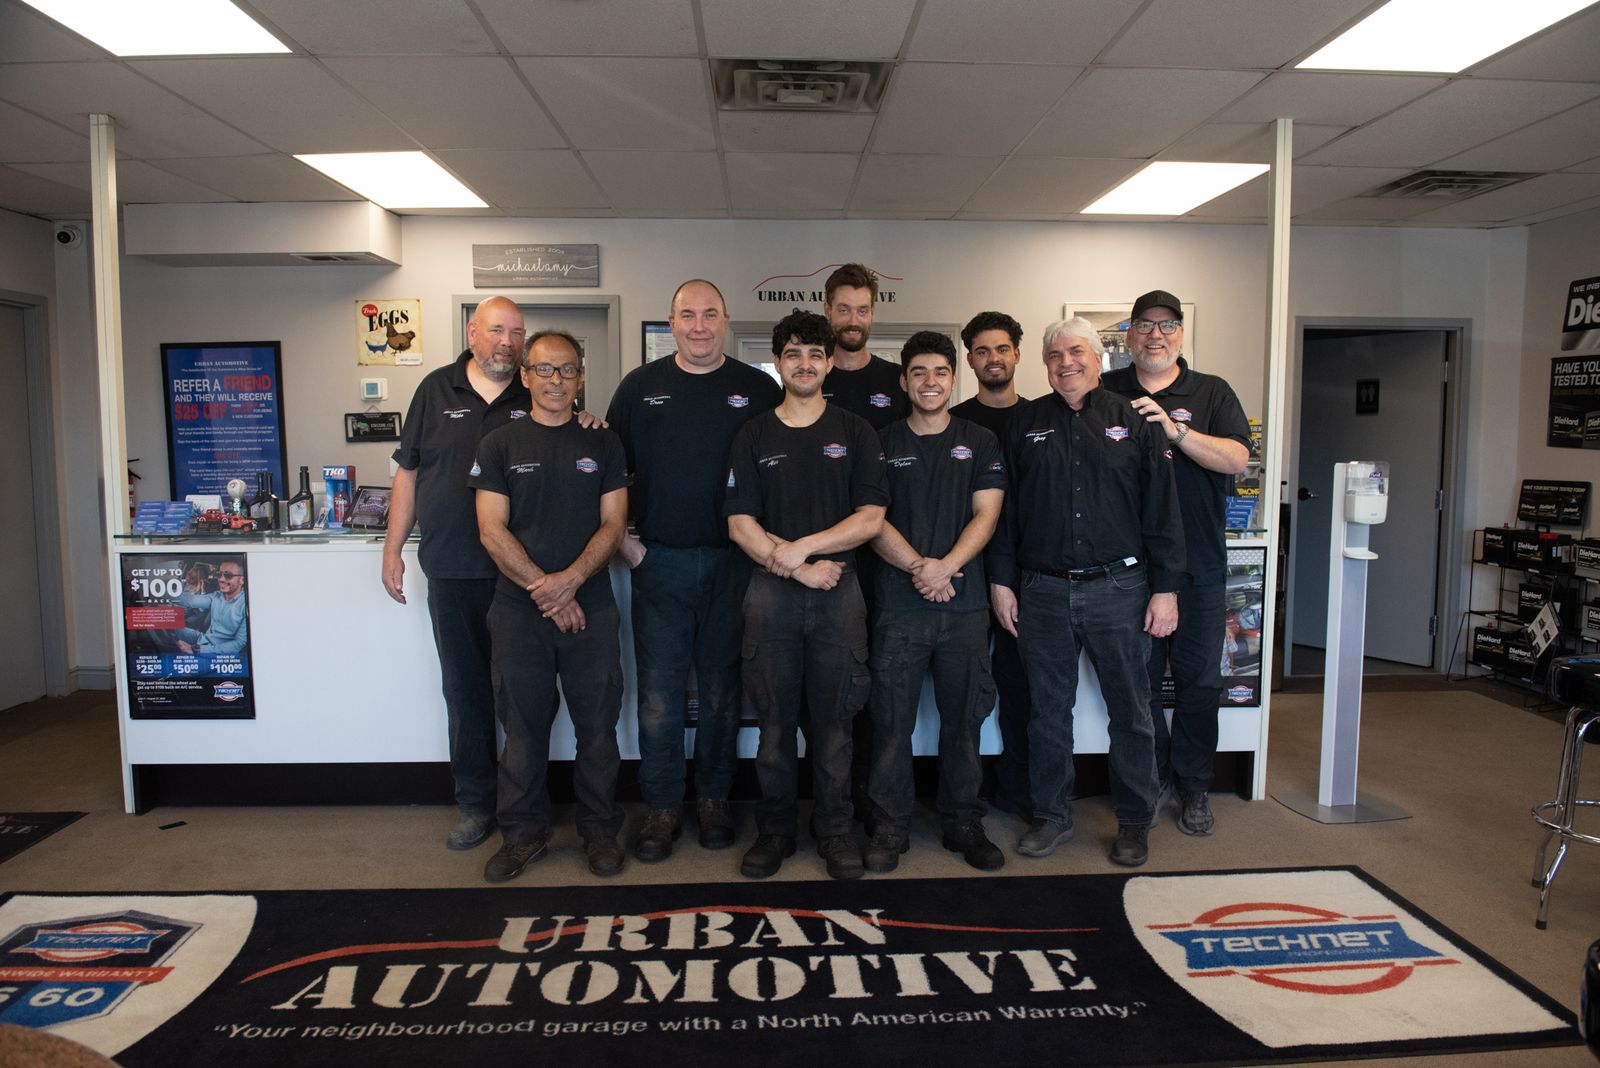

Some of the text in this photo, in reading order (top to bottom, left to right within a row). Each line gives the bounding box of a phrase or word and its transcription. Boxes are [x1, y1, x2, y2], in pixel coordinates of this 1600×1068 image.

[1573, 285, 1585, 293] WE
[758, 290, 806, 302] URBAN
[368, 310, 409, 332] EGGS
[1554, 362, 1580, 374] HAVE
[174, 375, 272, 392] REFER A FRIEND
[1553, 374, 1588, 386] TESTED
[174, 394, 192, 402] AND
[194, 394, 216, 402] THEY
[238, 393, 272, 401] RECEIVE
[175, 403, 200, 420] $25
[1554, 416, 1580, 426] DieHard
[1518, 542, 1539, 551] DieHard
[1521, 591, 1542, 600] DieHard
[1477, 634, 1502, 644] DieHard
[1509, 647, 1531, 657] DieHard
[497, 909, 887, 953] URBAN
[59, 969, 158, 977] WARRANTY
[271, 948, 1097, 1010] AUTOMOTIVE
[28, 987, 105, 1007] 60
[214, 1001, 1146, 1040] “Your neighbourhood garage with a North American Warranty.”
